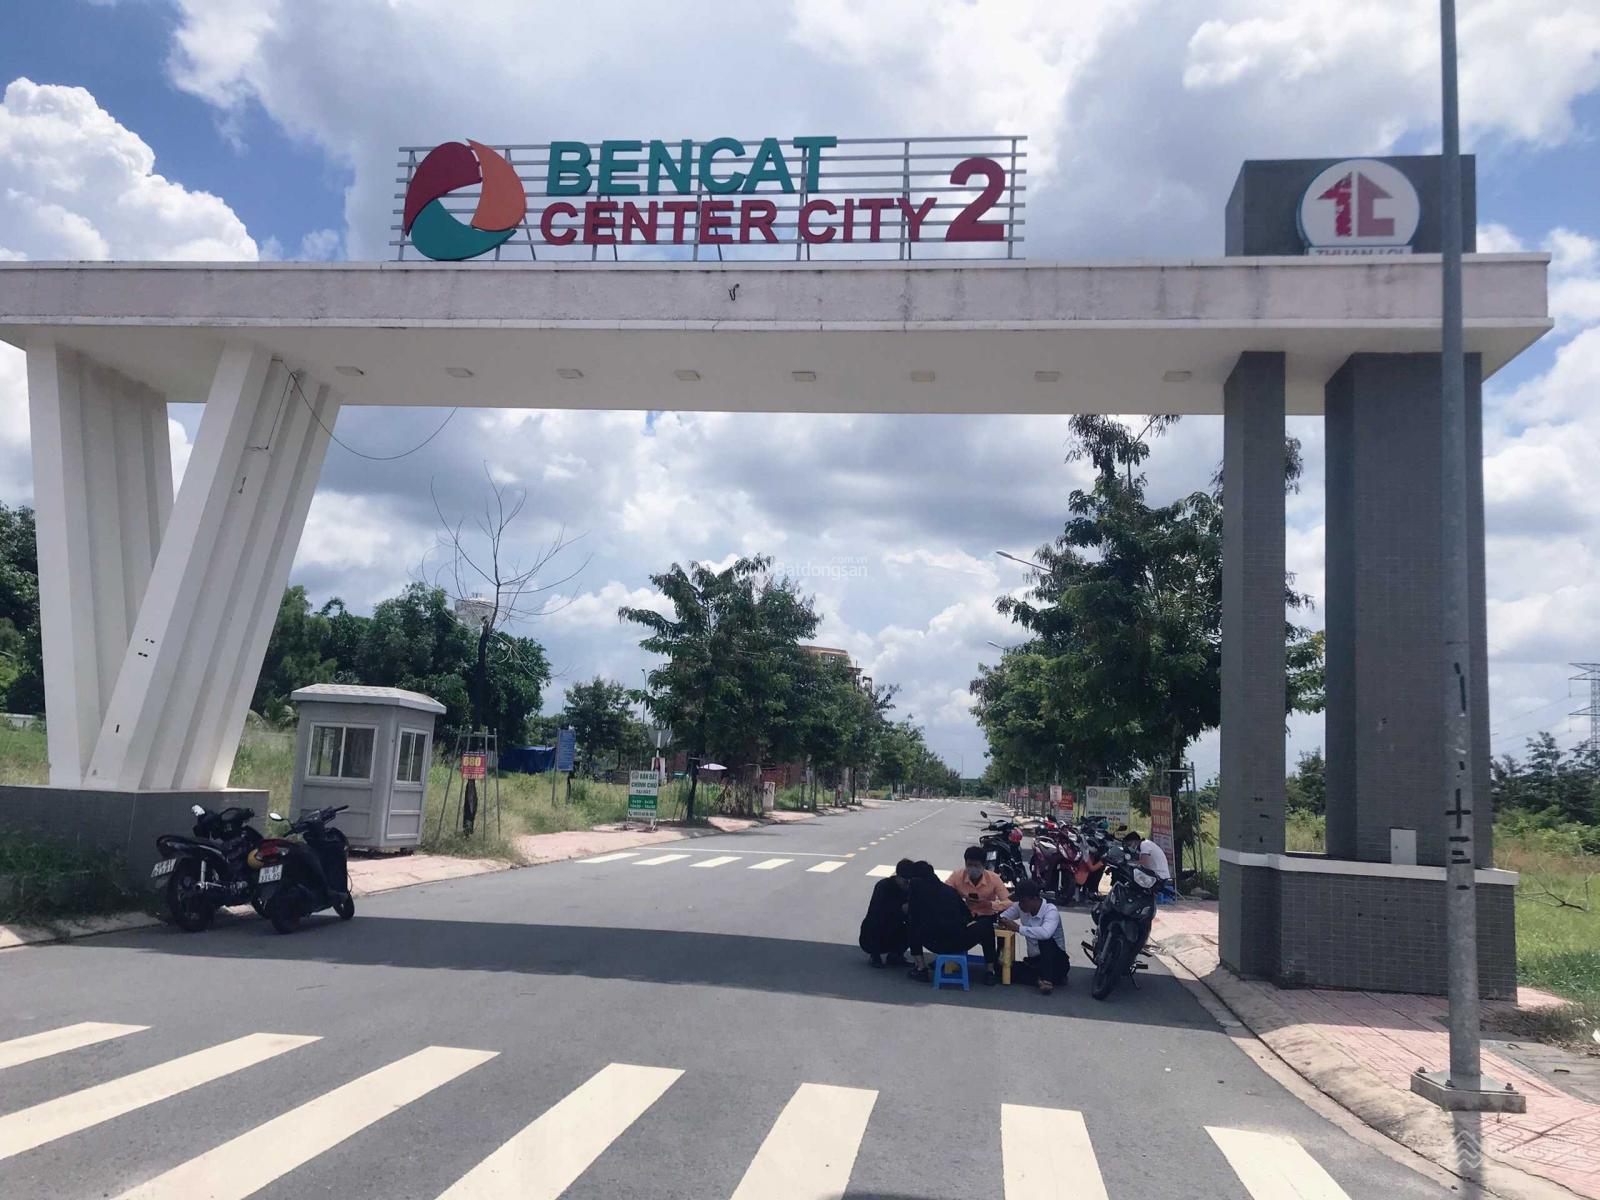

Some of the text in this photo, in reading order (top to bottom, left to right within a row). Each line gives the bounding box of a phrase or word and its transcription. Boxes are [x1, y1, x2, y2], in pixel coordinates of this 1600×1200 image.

[540, 156, 1005, 246] CENTER CITY 2
[546, 137, 836, 194] BENCAT
